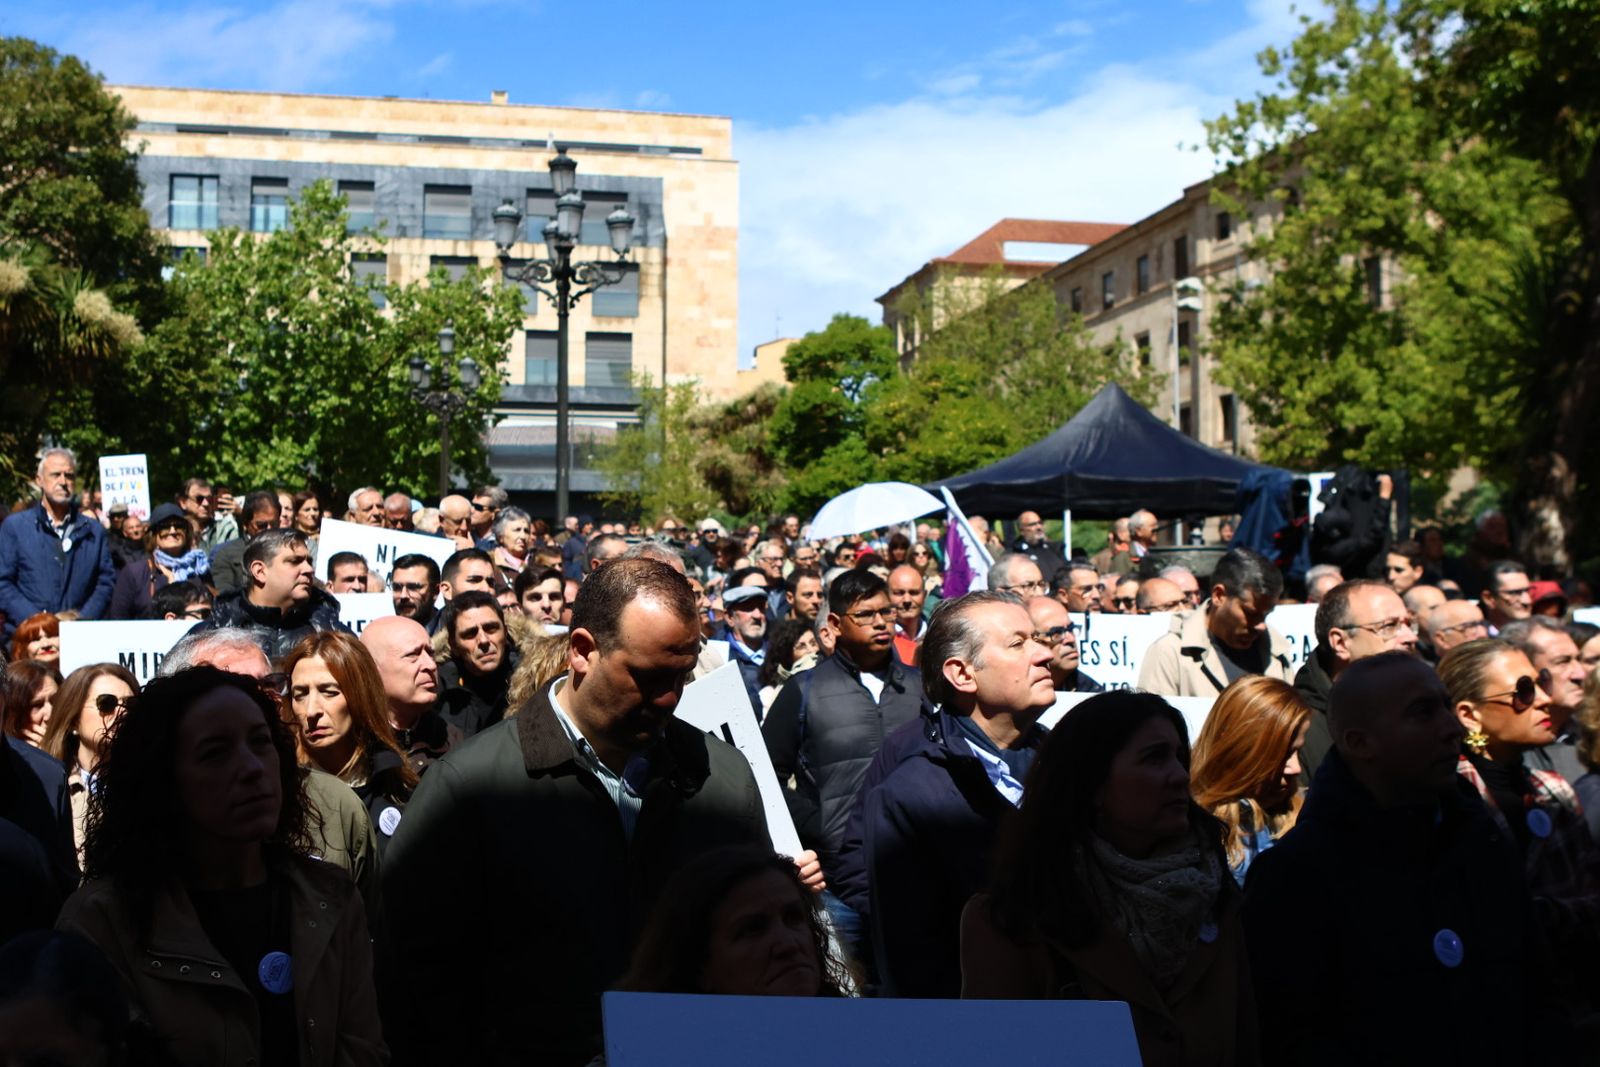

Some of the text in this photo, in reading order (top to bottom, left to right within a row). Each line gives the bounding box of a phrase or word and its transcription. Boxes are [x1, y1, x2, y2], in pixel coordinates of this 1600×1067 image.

[105, 466, 144, 477] EL TREN
[105, 482, 116, 491] DE
[1109, 635, 1135, 671] SÍ,
